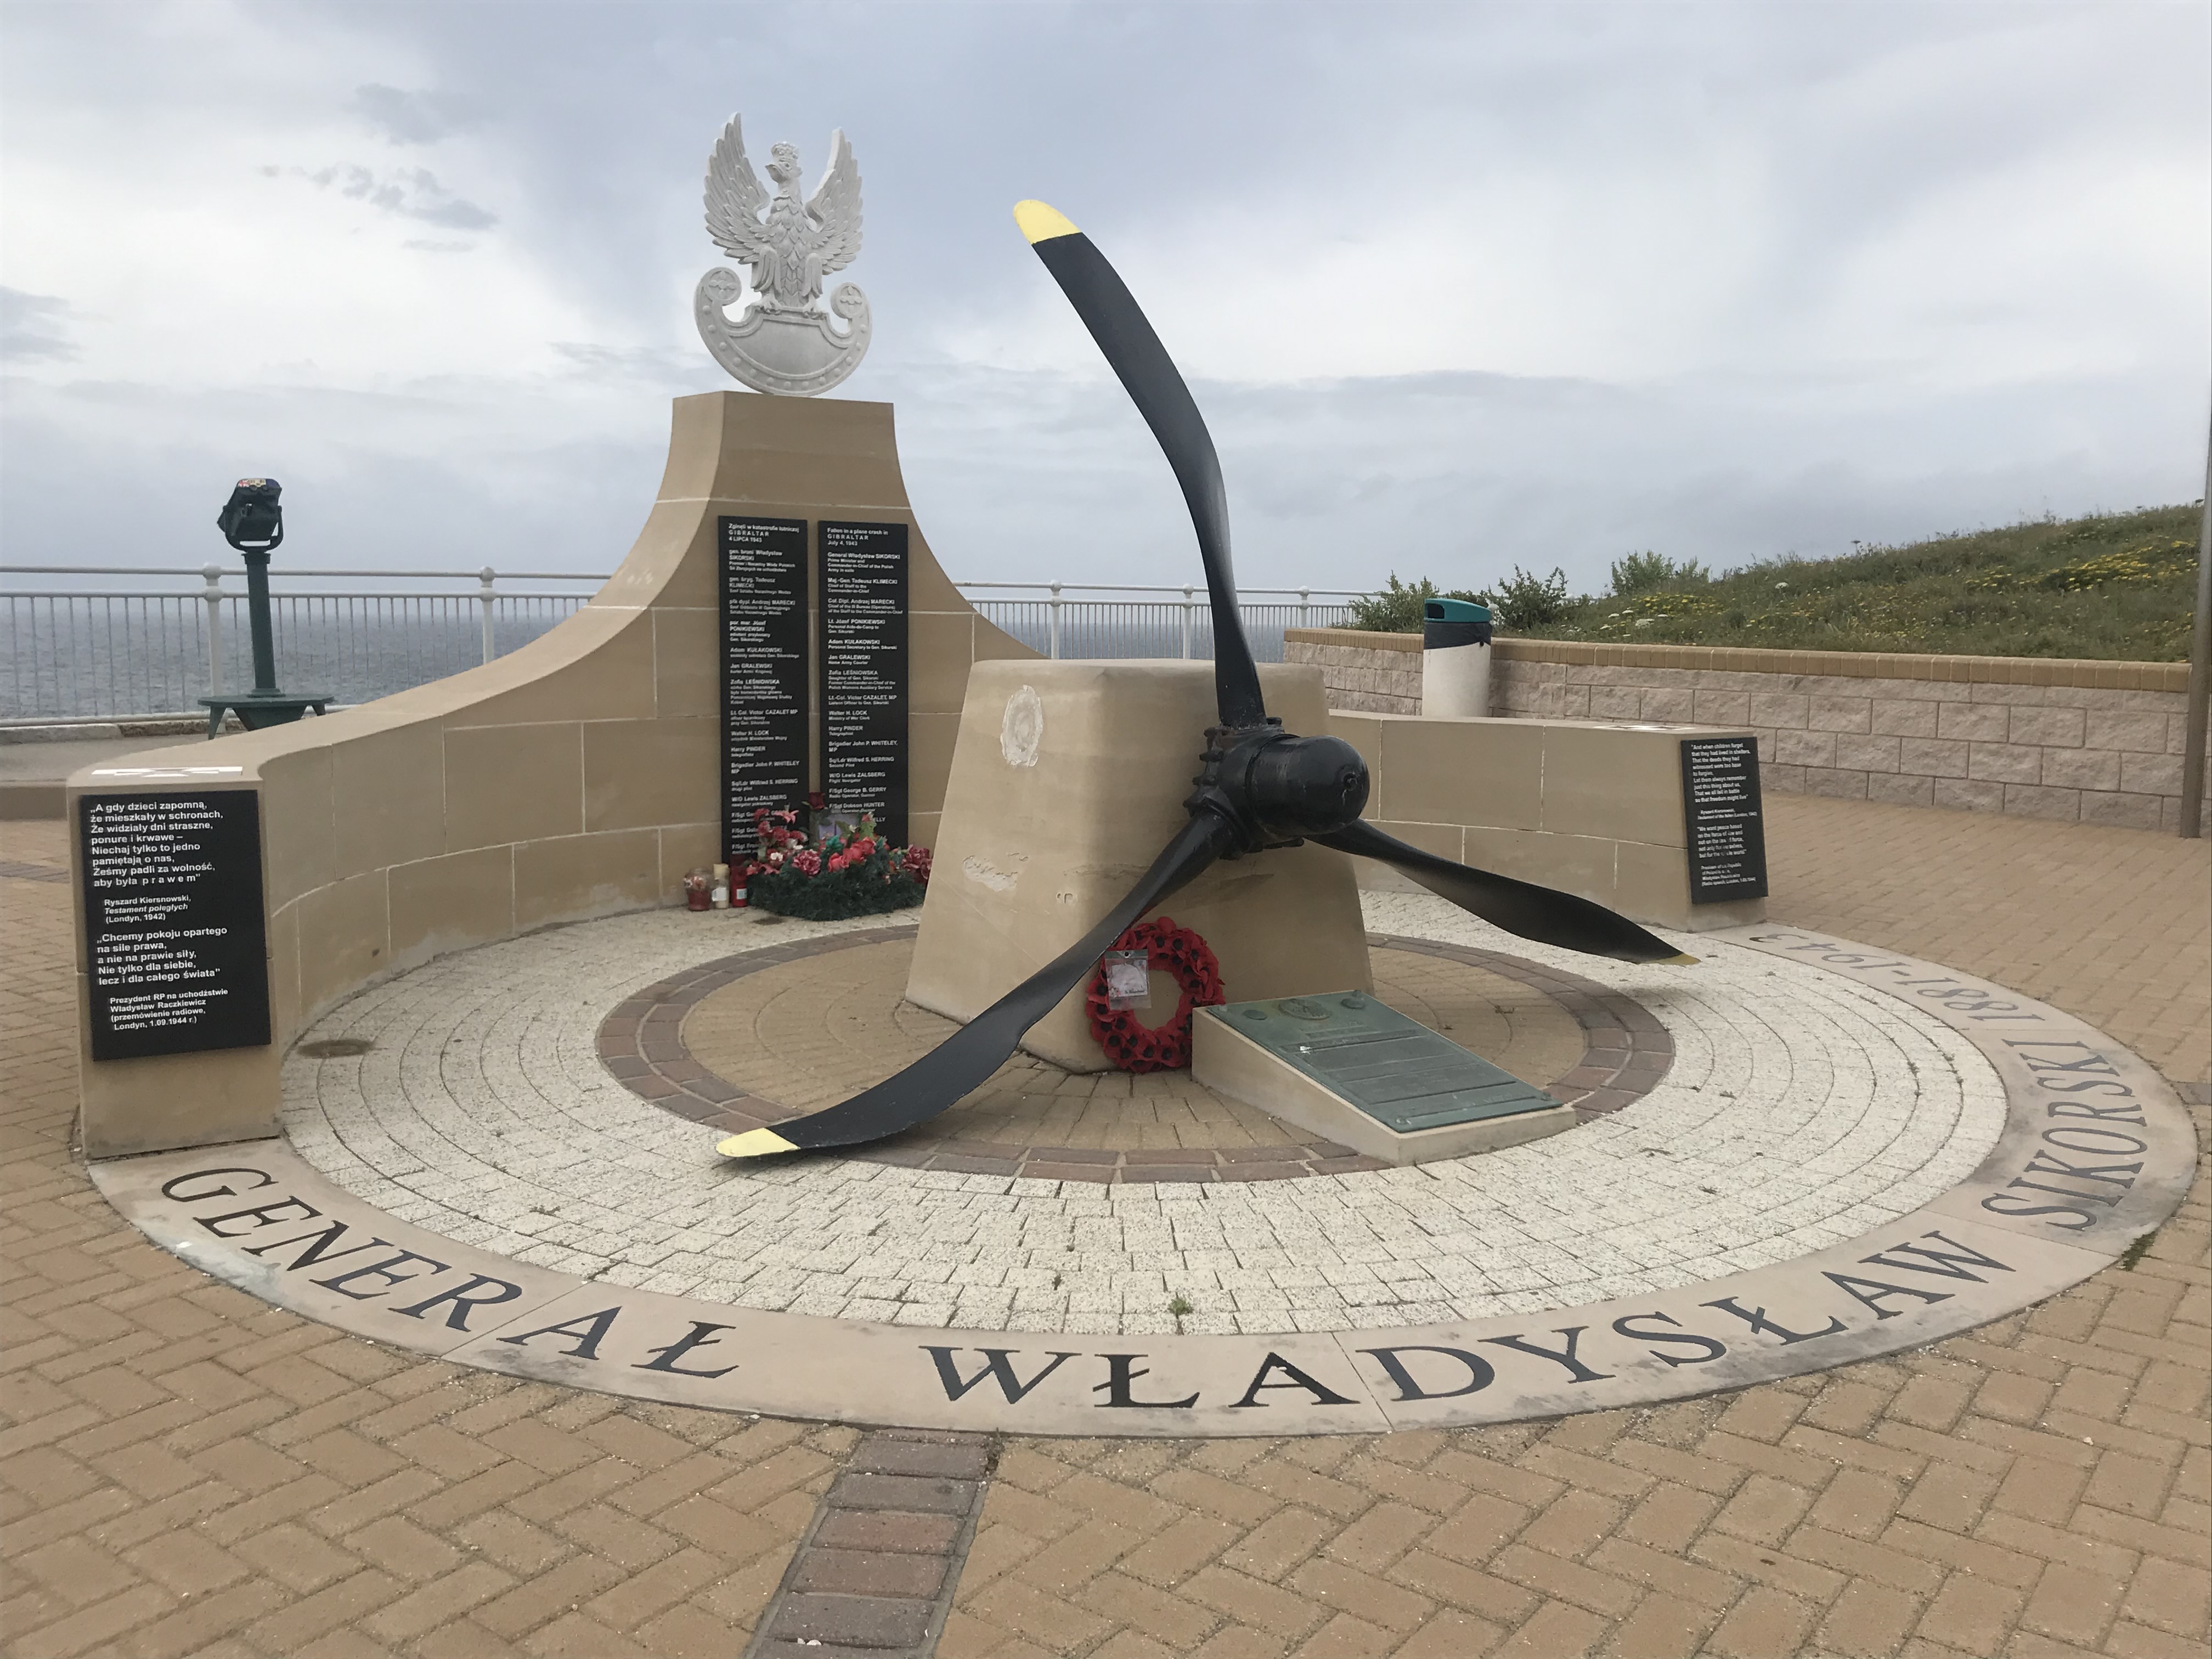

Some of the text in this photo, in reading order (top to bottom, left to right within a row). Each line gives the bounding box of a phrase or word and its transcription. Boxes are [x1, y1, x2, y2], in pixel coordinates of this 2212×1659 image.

[106, 803, 125, 813] gdy
[128, 802, 157, 810] dzieci
[160, 802, 207, 811] zapomną,
[90, 815, 102, 824] że
[105, 813, 156, 822] mieszkały
[169, 810, 223, 819] schronach,
[91, 824, 104, 833] Że
[107, 824, 148, 833] widziały
[151, 823, 166, 831] dni
[91, 837, 127, 846] ponure
[92, 845, 130, 855] Niechaj
[133, 845, 157, 854] tylko
[173, 843, 200, 853] jedno
[93, 856, 142, 867] pamiętają
[131, 865, 155, 876] padli
[172, 862, 215, 872] wolność,
[94, 879, 112, 888] aby
[104, 895, 191, 907] Ryszard Kiersnowski,
[105, 906, 147, 914] Testament
[106, 916, 142, 924] (Londyn,
[147, 930, 180, 941] pokoju
[183, 928, 227, 938] opartego
[113, 944, 130, 952] sile
[134, 943, 167, 952] prawa,
[107, 955, 122, 963] nie
[141, 951, 173, 962] prawie
[177, 950, 196, 959] siły,
[98, 966, 115, 974] Nie
[118, 964, 143, 974] tylko
[164, 960, 196, 969] siebie,
[146, 973, 180, 981] całego
[110, 995, 151, 1004] Prezydent
[158, 999, 206, 1008] Raczkiewicz
[114, 1022, 147, 1030] Londyn,
[150, 1017, 187, 1026] 1.09.1944
[162, 1167, 739, 1379] GENERAŁ
[918, 1231, 2016, 1408] WŁADYSŁAW
[1981, 1038, 2148, 1232] SIKORSKI
